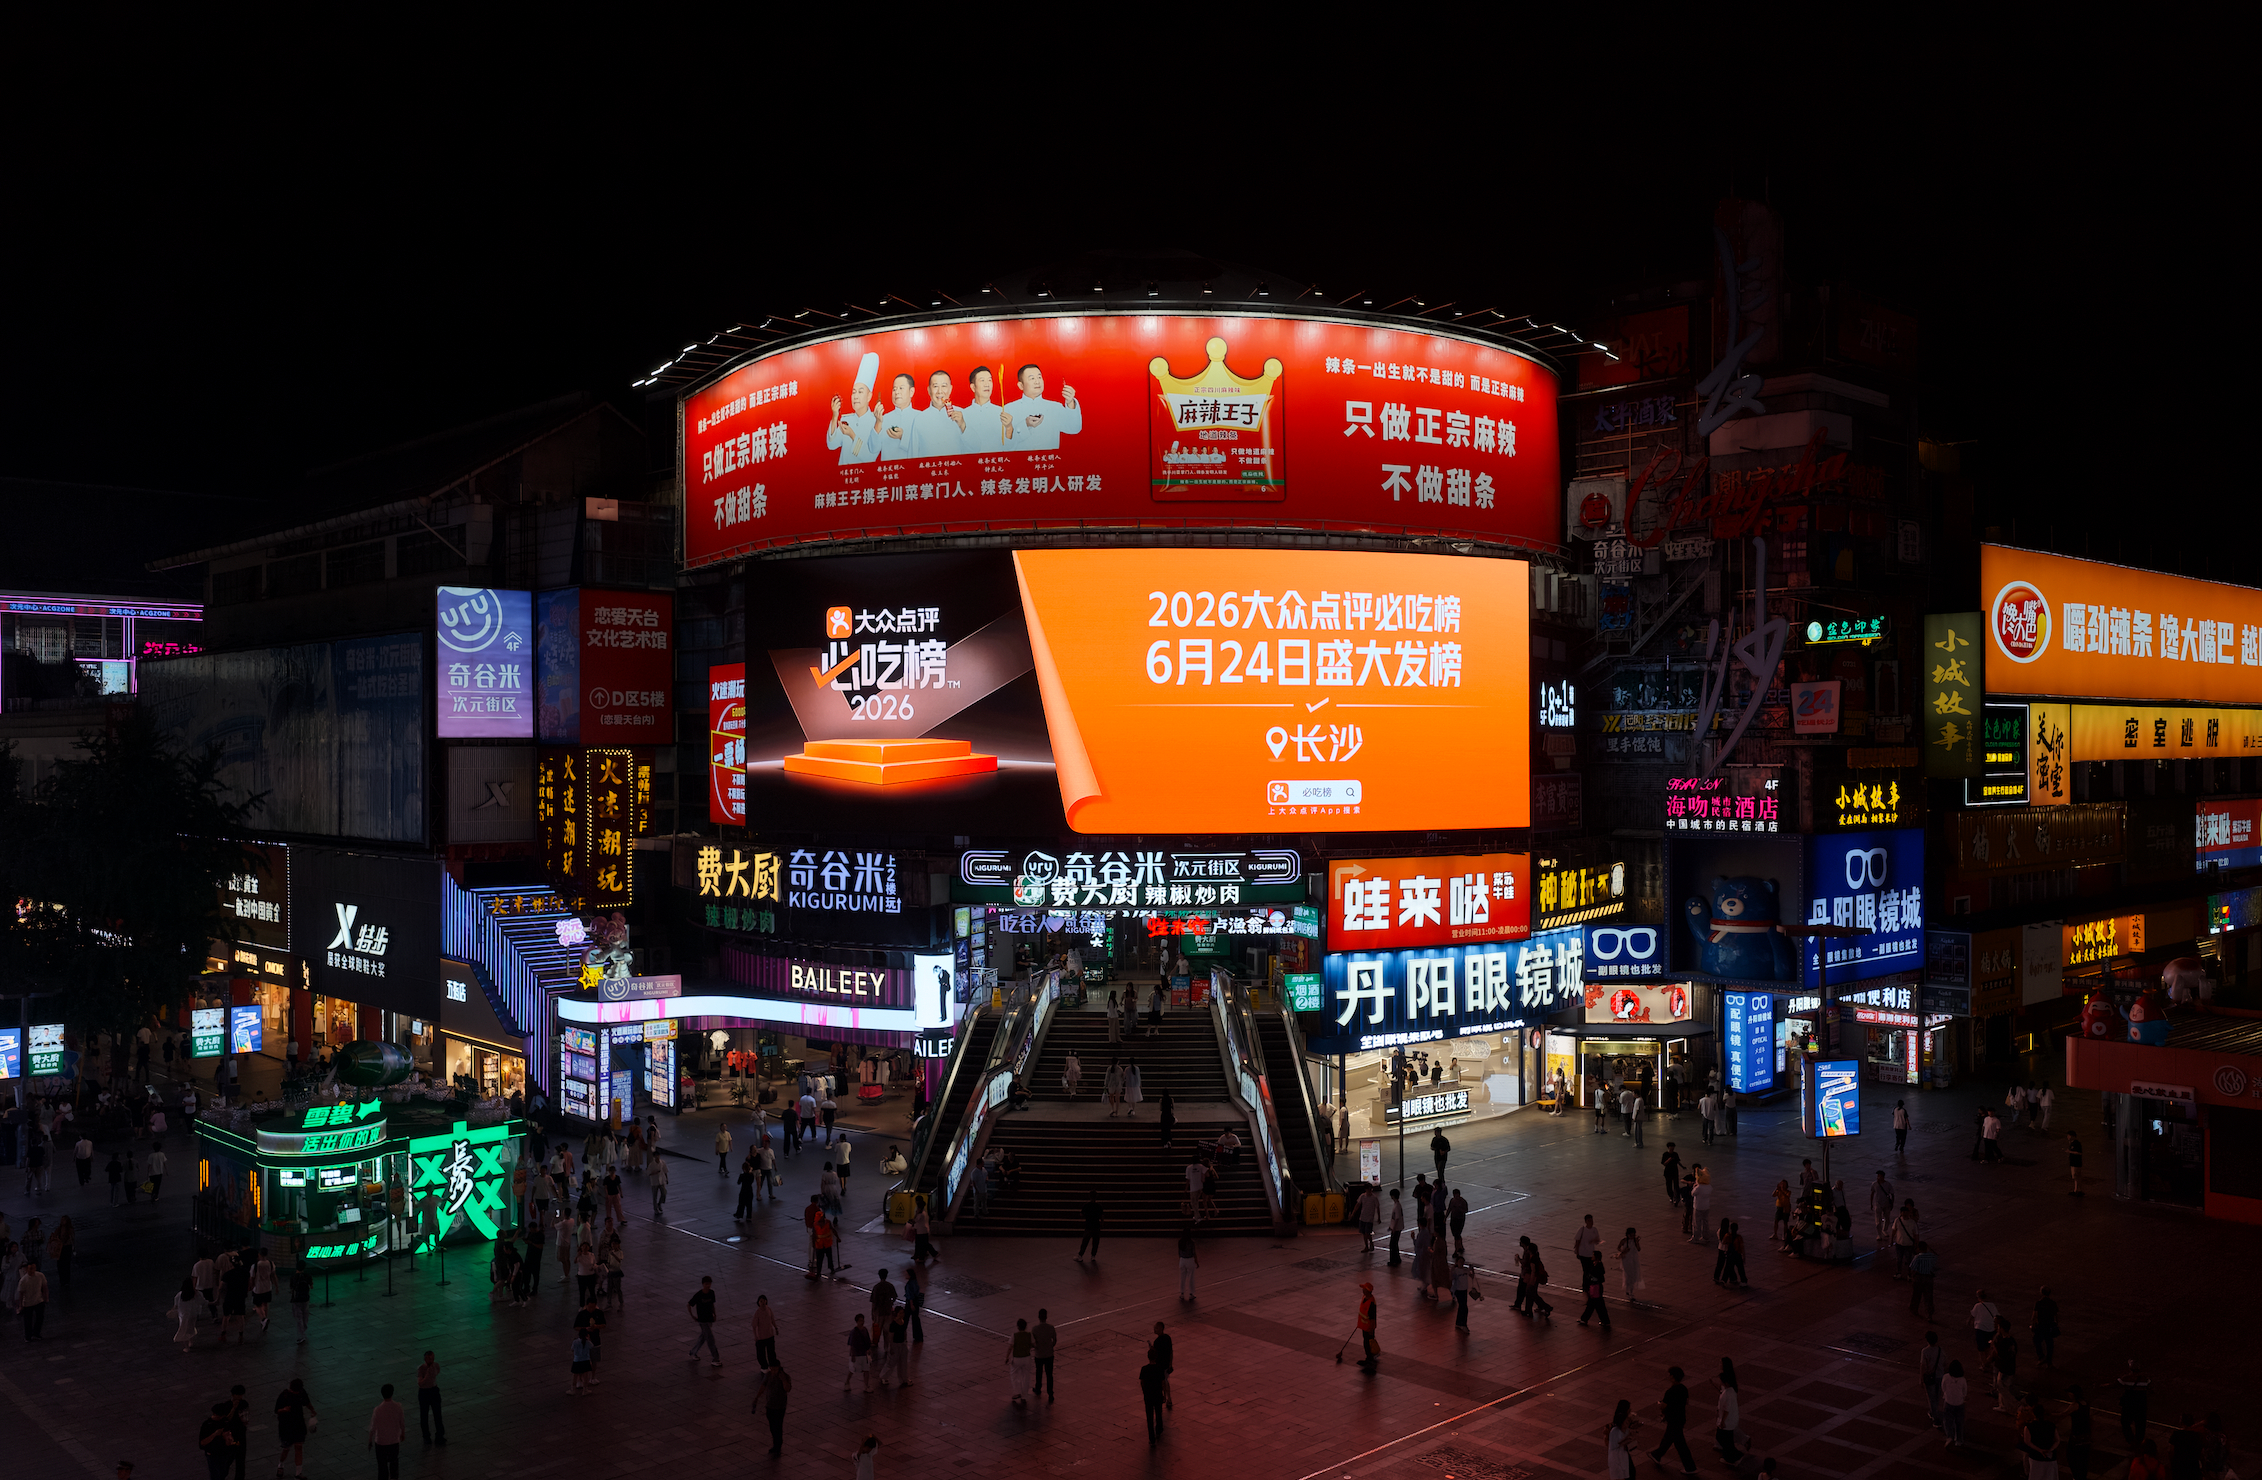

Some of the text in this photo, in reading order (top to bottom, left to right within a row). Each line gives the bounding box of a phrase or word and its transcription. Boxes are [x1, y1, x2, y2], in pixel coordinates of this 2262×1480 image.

[1325, 355, 1525, 403] 辣条一出生就不是甜的 而是正宗麻辣
[749, 380, 798, 412] 而是正宗麻辣
[1178, 399, 1259, 426] 麻辣王子
[1344, 399, 1517, 459] 只做正宗麻辣
[702, 420, 788, 485] 只做正宗麻辣
[814, 474, 1103, 509] 麻辣王子携手川菜掌门人、辣条发明人研发
[1381, 463, 1496, 511] 不做甜条
[714, 486, 768, 531] 不做甜条
[9, 603, 76, 613] 次元中心·ACGZONE
[594, 606, 659, 627] 恋爱天台
[854, 606, 940, 634] 大众点评
[1147, 589, 1461, 634] 2026大众点评必吃榜
[506, 641, 521, 652] 4F
[586, 629, 667, 650] 文化艺术馆
[2062, 602, 2153, 658] 嚼劲辣条
[2159, 612, 2236, 665] 馋大嘴巴
[447, 662, 522, 689] 奇谷米
[809, 637, 947, 692] 必吃榜
[1145, 638, 1462, 688] 6月24日盛大发榜
[612, 691, 665, 707] D区5楼
[1797, 690, 1834, 716] 24
[1931, 628, 1972, 752] 小城故事
[452, 696, 517, 713] 次元街区
[851, 694, 915, 721] 2026
[600, 714, 655, 726] (恋爱天台内)
[1985, 717, 2021, 740] 金色印象
[2124, 717, 2219, 749] 密室逃脱
[1289, 723, 1363, 763] 长沙
[1302, 786, 1333, 799] 必吃榜
[1764, 779, 1779, 791] 4F
[1835, 781, 1901, 812] 小城故事
[562, 754, 578, 878] 火迷潮玩
[638, 808, 649, 833] 3F
[1267, 805, 1362, 816] 上大众点评App搜索
[1666, 795, 1708, 819] 海吻
[1735, 795, 1779, 821] 酒店
[597, 757, 624, 893] 火迷潮玩
[1666, 818, 1779, 833] 中国城市的民宿酒店
[697, 845, 781, 903] 费大厨
[789, 849, 884, 894] 奇谷米
[1064, 851, 1166, 886] 奇谷米
[1173, 860, 1241, 878] 次元街区
[1248, 862, 1287, 871] KIGURUMI
[1493, 872, 1514, 886] 紫苏
[789, 891, 883, 913] KIGURUMI
[1050, 876, 1241, 907] 费大厨 辣椒炒肉
[1342, 873, 1490, 931] 蛙来哒
[1493, 886, 1514, 900] 牛蛙
[704, 903, 775, 934] 辣椒炒肉
[1000, 914, 1053, 934] 吃谷人
[1807, 886, 1921, 944] 丹阳眼镜城
[354, 923, 389, 956] 特步
[1451, 925, 1528, 939] 营业时间11:00-凌晨00:00
[2072, 917, 2117, 948] 小城故事
[326, 951, 386, 978] 屡获全球跑鞋大奖
[1812, 946, 1862, 966] 全眼镜集散地
[791, 964, 885, 997] BAILEEY
[1335, 937, 1584, 1028] 丹阳眼镜城
[1586, 963, 1663, 977] 一副眼镜也批发
[630, 982, 655, 991] 奇谷米
[1295, 983, 1320, 997] 烟酒
[1839, 986, 1912, 1011] 便利店
[1730, 1008, 1741, 1047] 配眼镜
[195, 1036, 221, 1047] 费大厨
[1730, 1051, 1742, 1090] 真便宜
[302, 1105, 355, 1129] 雪碧
[301, 1127, 380, 1152] 活出你的爽
